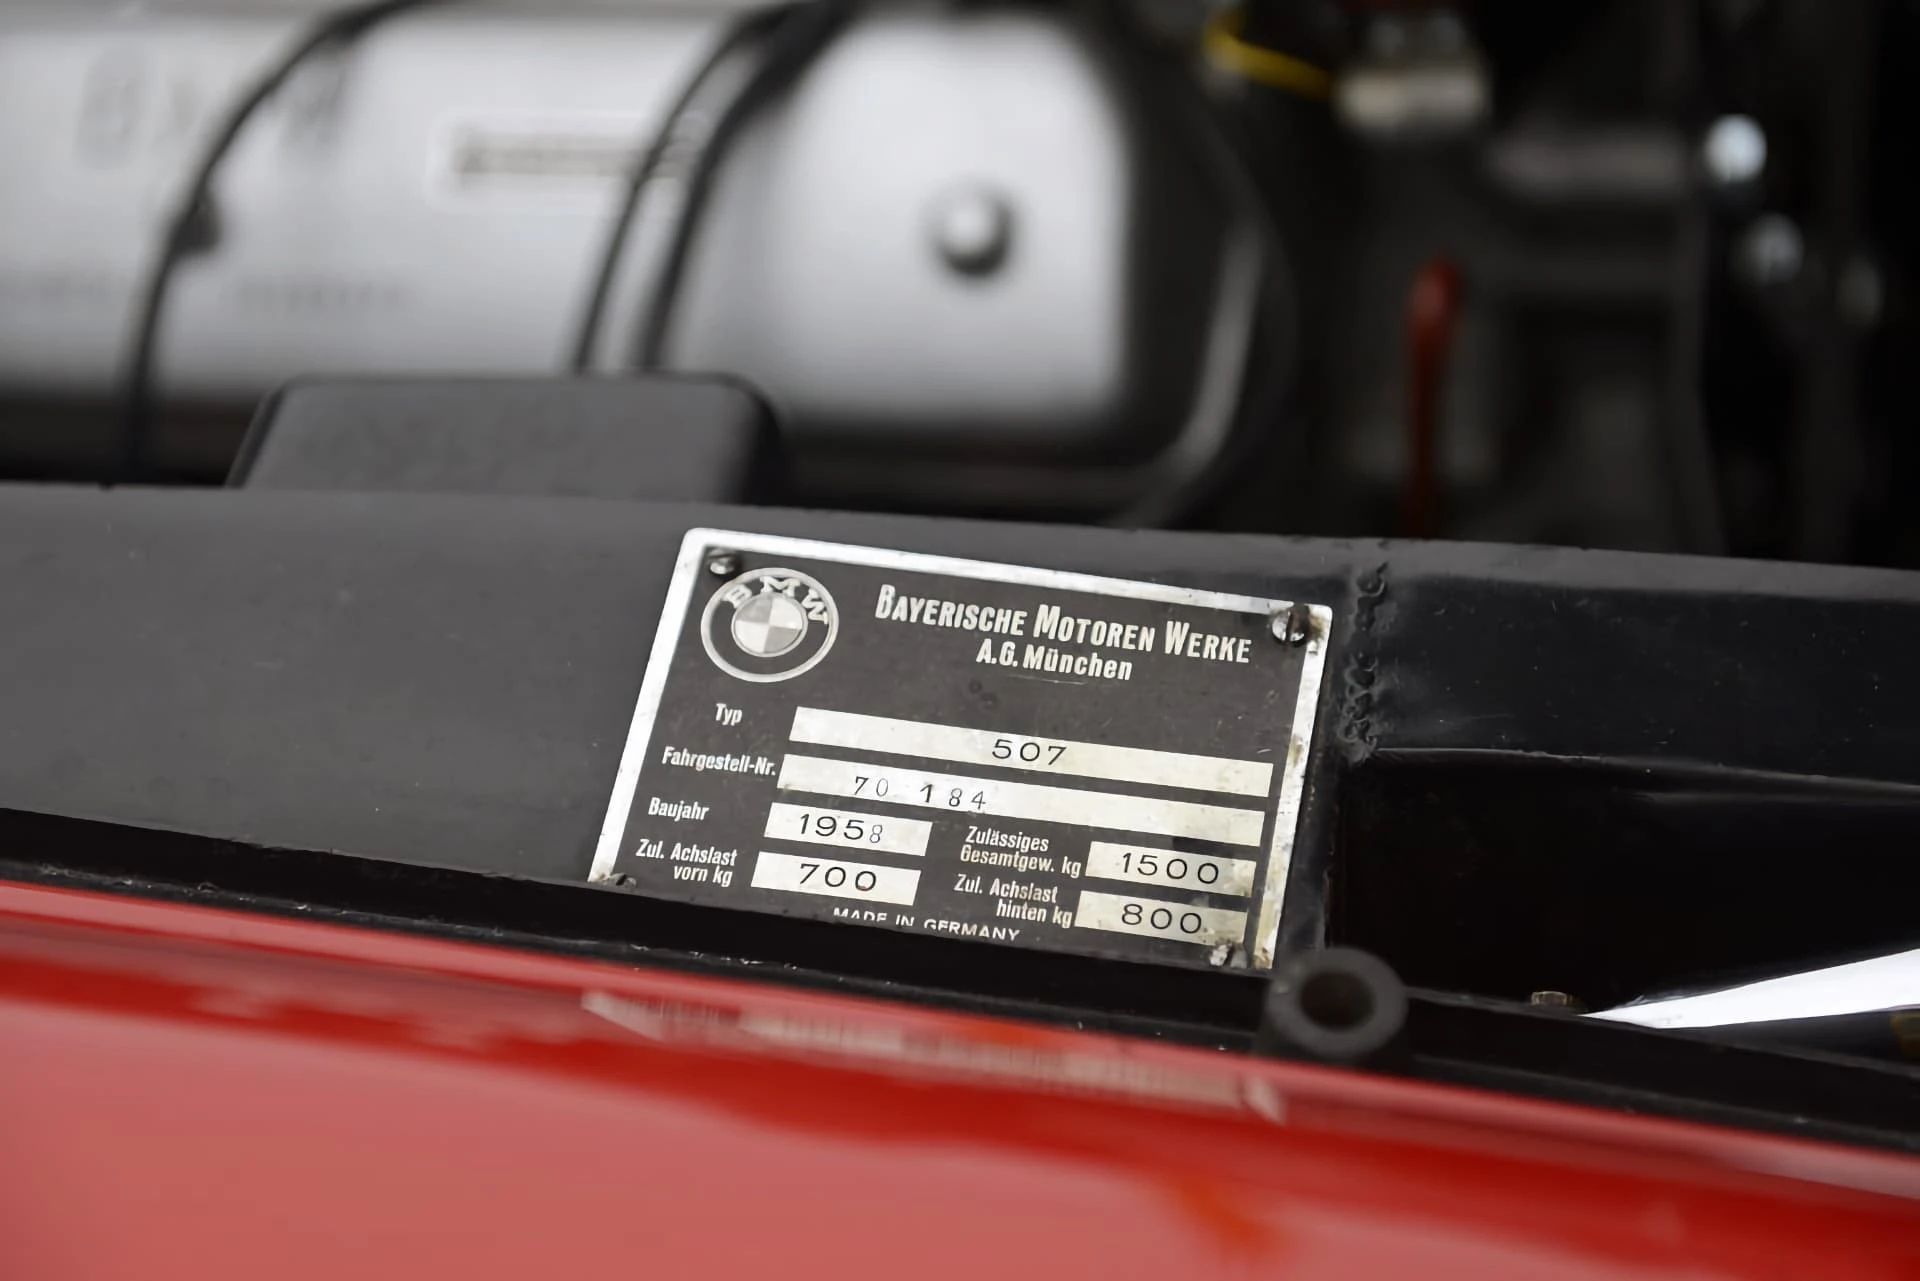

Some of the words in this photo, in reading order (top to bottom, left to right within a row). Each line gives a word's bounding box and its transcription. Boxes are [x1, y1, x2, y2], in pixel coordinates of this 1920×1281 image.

[720, 575, 828, 625] BMW
[875, 584, 1028, 636] BAYERISCHE
[1033, 604, 1156, 652] MOTOREN
[1165, 620, 1252, 663] WERKE
[976, 638, 1018, 667] A.G.
[1022, 644, 1133, 681] München
[715, 702, 743, 726] Typ
[661, 745, 776, 776] Fahrgestell-Nr.
[991, 738, 1067, 766] 507
[853, 776, 889, 797] 70
[648, 796, 710, 822] Baujahr
[799, 812, 883, 845] 1958
[965, 825, 1049, 853] Zulässiges
[635, 838, 665, 860] Zul.
[670, 842, 738, 866] Achslast
[960, 844, 1055, 872] Gesamtgew.
[1061, 855, 1082, 879] kg
[673, 863, 708, 883] vorn
[712, 866, 733, 887] kg
[799, 862, 877, 892] 700
[1122, 852, 1219, 884] 1500
[954, 873, 983, 894] Zul.
[989, 877, 1058, 904] Achslast
[895, 914, 915, 927] IN
[923, 918, 1020, 941] GERMANY
[996, 898, 1048, 923] hinten
[1052, 905, 1073, 929] kg
[1121, 902, 1202, 934] 800
